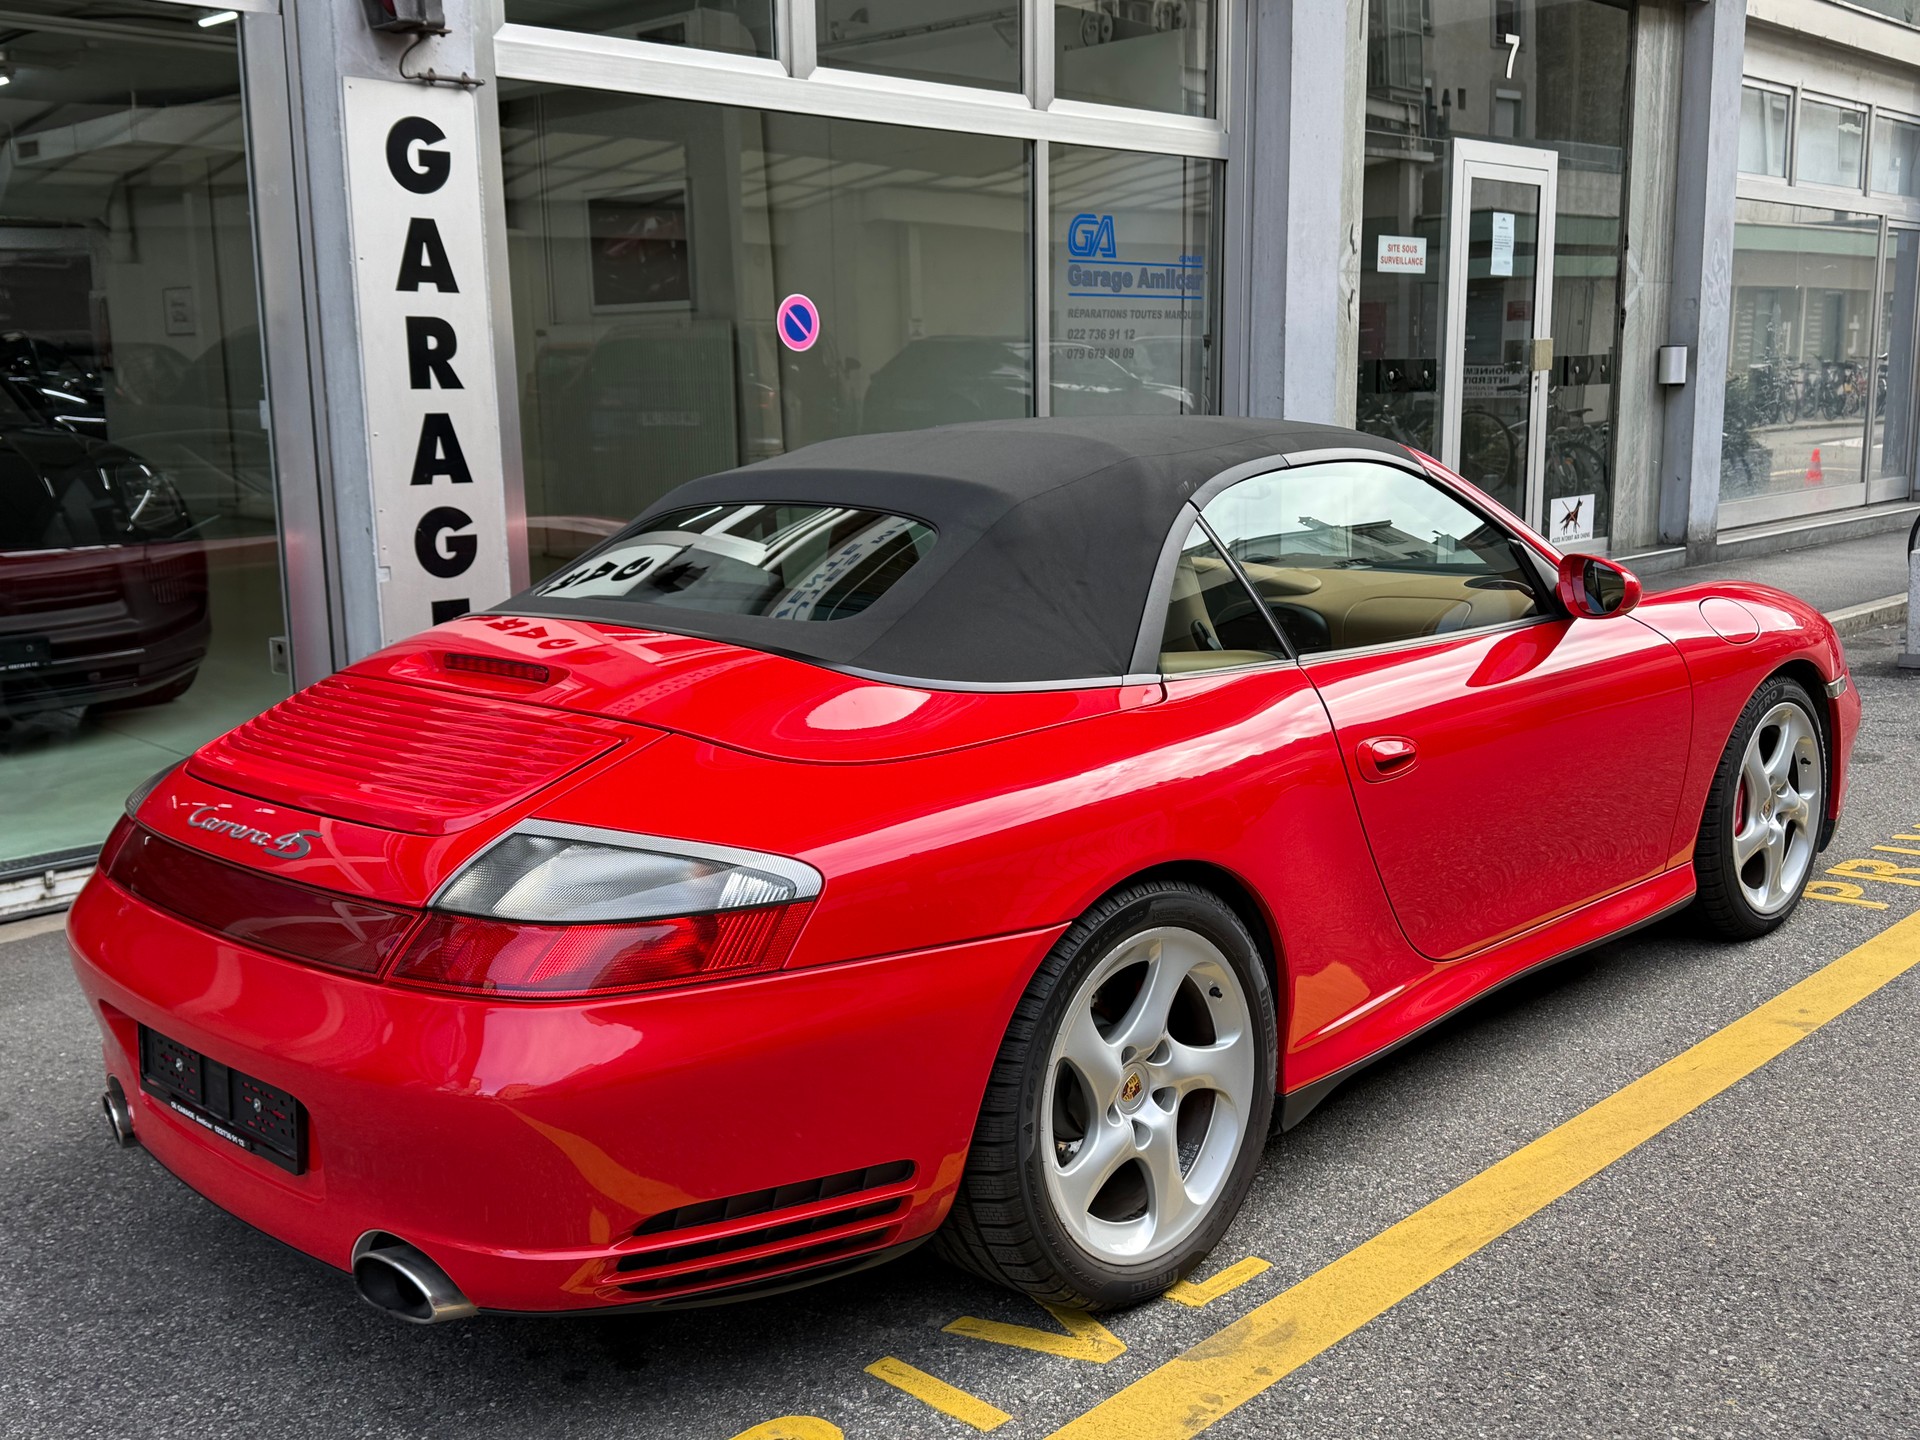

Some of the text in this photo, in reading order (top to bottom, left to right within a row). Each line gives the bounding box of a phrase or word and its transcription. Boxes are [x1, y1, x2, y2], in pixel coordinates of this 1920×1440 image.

[1505, 33, 1520, 79] 7
[1068, 213, 1117, 259] GA
[1387, 243, 1418, 254] SITE SOUS
[1380, 255, 1424, 266] SURVEILLANCE
[1068, 264, 1203, 293] Garage Amilcar
[1130, 309, 1162, 319] TOUTES
[1067, 328, 1136, 340] 022 736 91 12
[1066, 348, 1135, 360] 079 679 80 09
[187, 806, 323, 860] Carrera 4S
